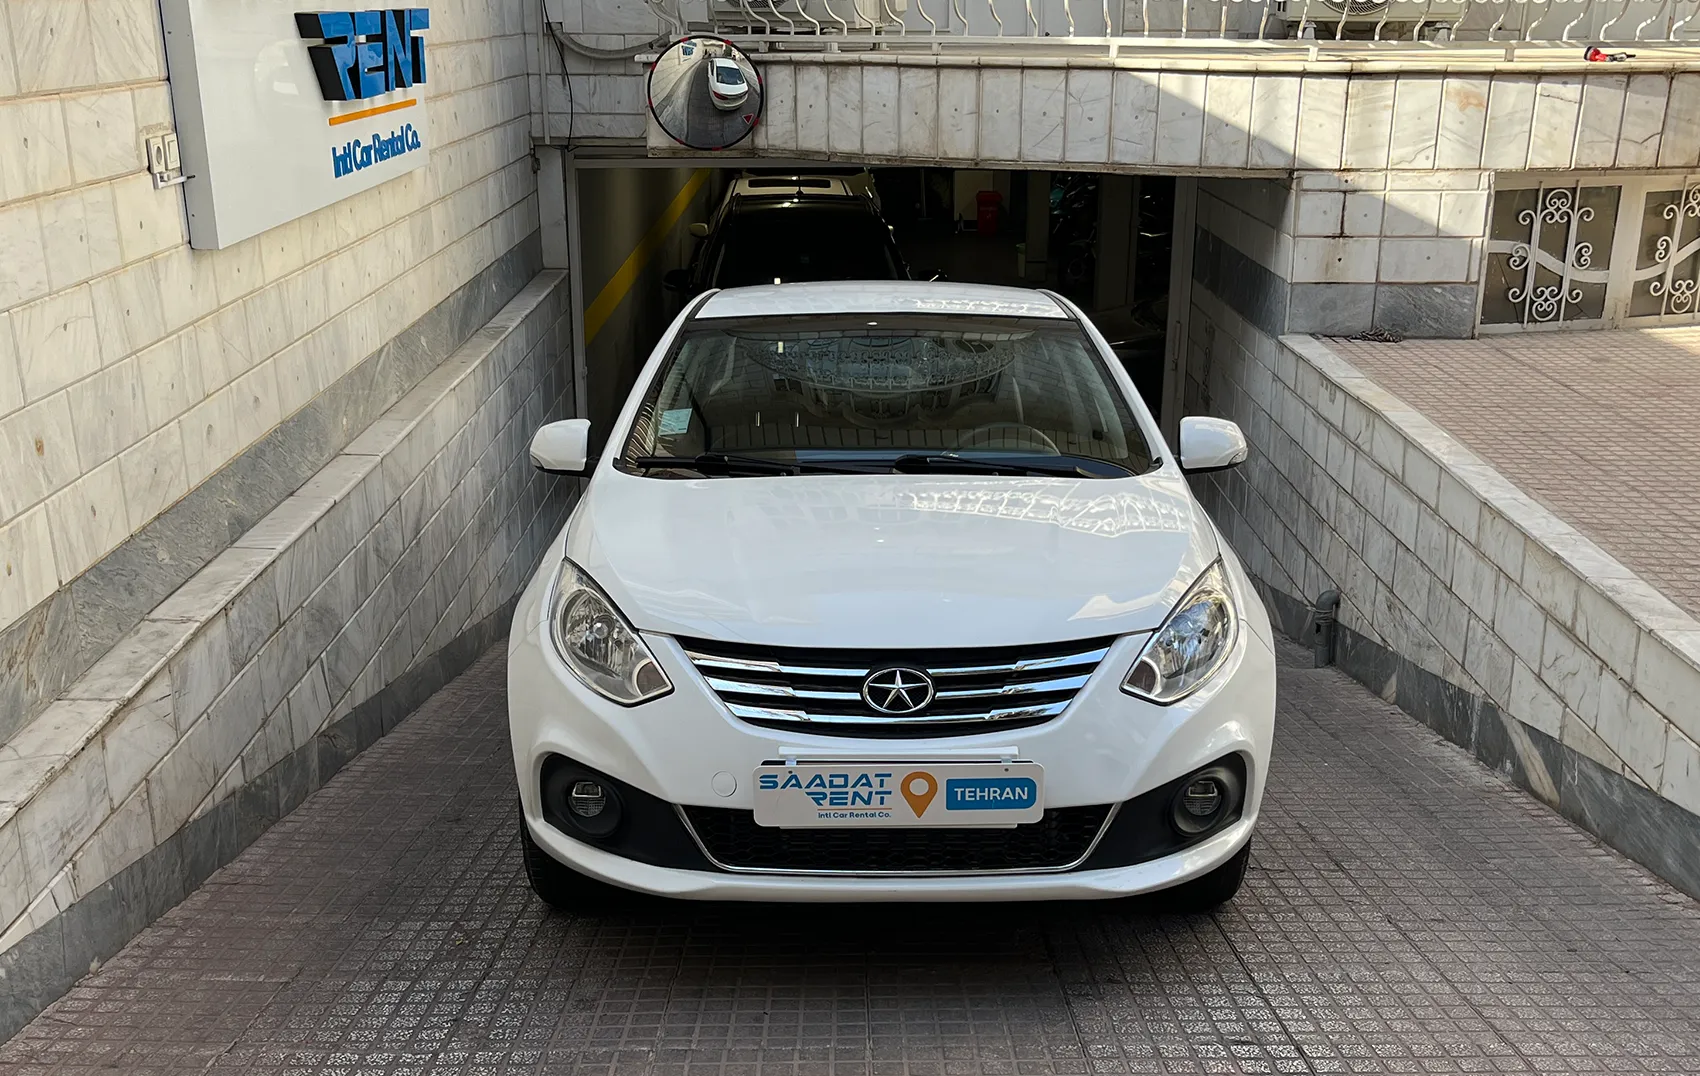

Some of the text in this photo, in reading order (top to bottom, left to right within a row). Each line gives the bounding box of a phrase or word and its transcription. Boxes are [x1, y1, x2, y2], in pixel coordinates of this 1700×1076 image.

[295, 8, 430, 101] RENT
[332, 123, 421, 178] Intl Car Rental Co.
[759, 773, 892, 789] SAADAT
[805, 790, 892, 806] RENT
[954, 787, 1028, 801] TEHRAN
[818, 811, 832, 819] Intl
[833, 811, 848, 819] Car
[849, 811, 877, 819] Rental
